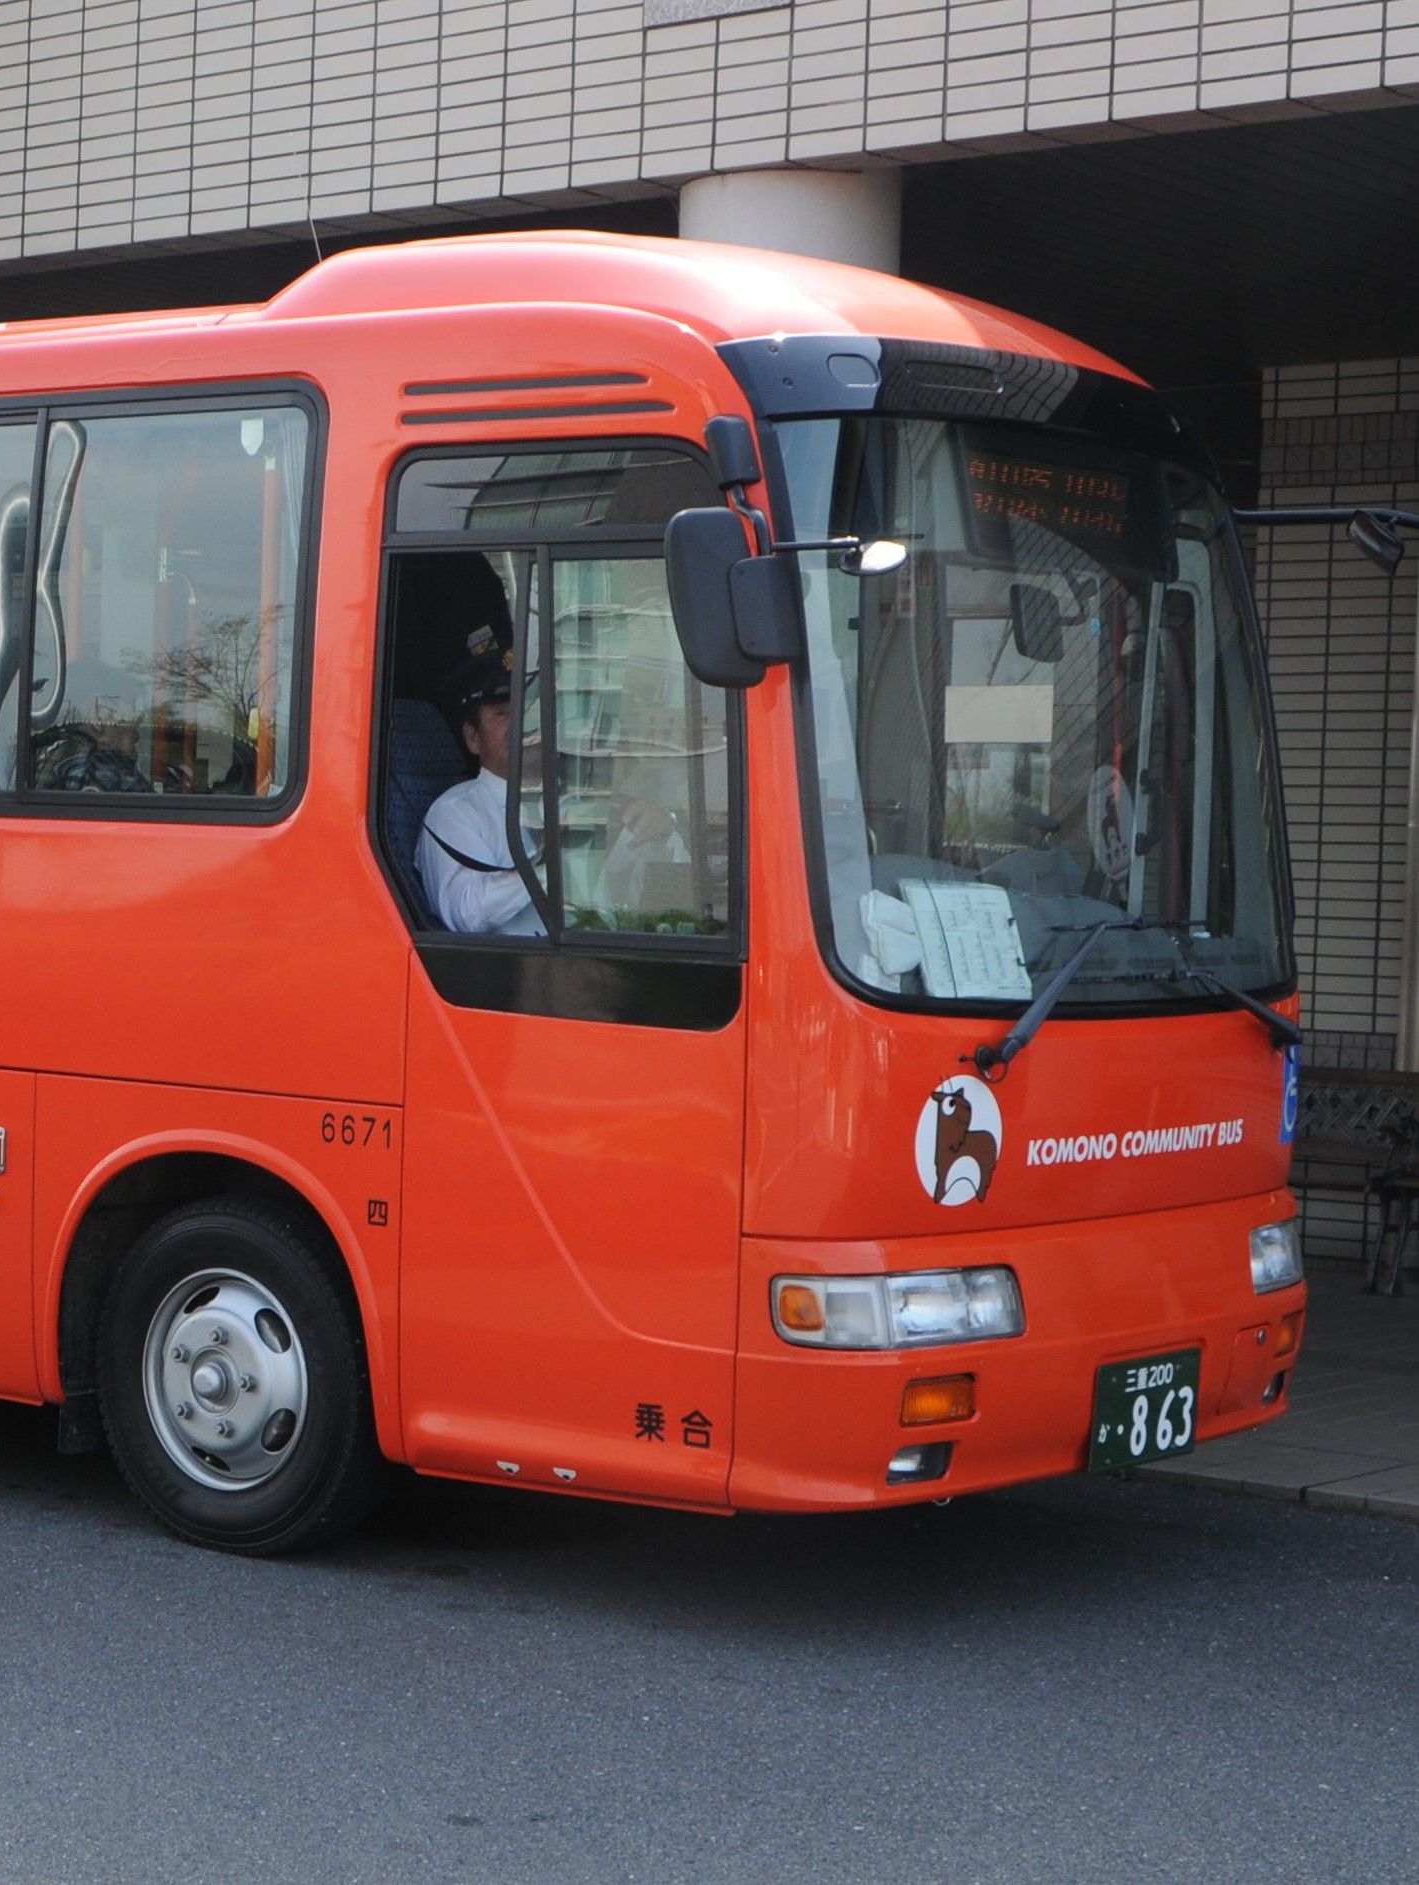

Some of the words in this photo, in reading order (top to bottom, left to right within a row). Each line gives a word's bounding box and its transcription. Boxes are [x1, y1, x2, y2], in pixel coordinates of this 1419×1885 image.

[321, 1112, 393, 1150] 6671
[1026, 1132, 1118, 1166] KOMONO
[1121, 1122, 1217, 1158] COMMUNITY
[1217, 1118, 1244, 1146] BUS
[368, 1199, 388, 1227] 四
